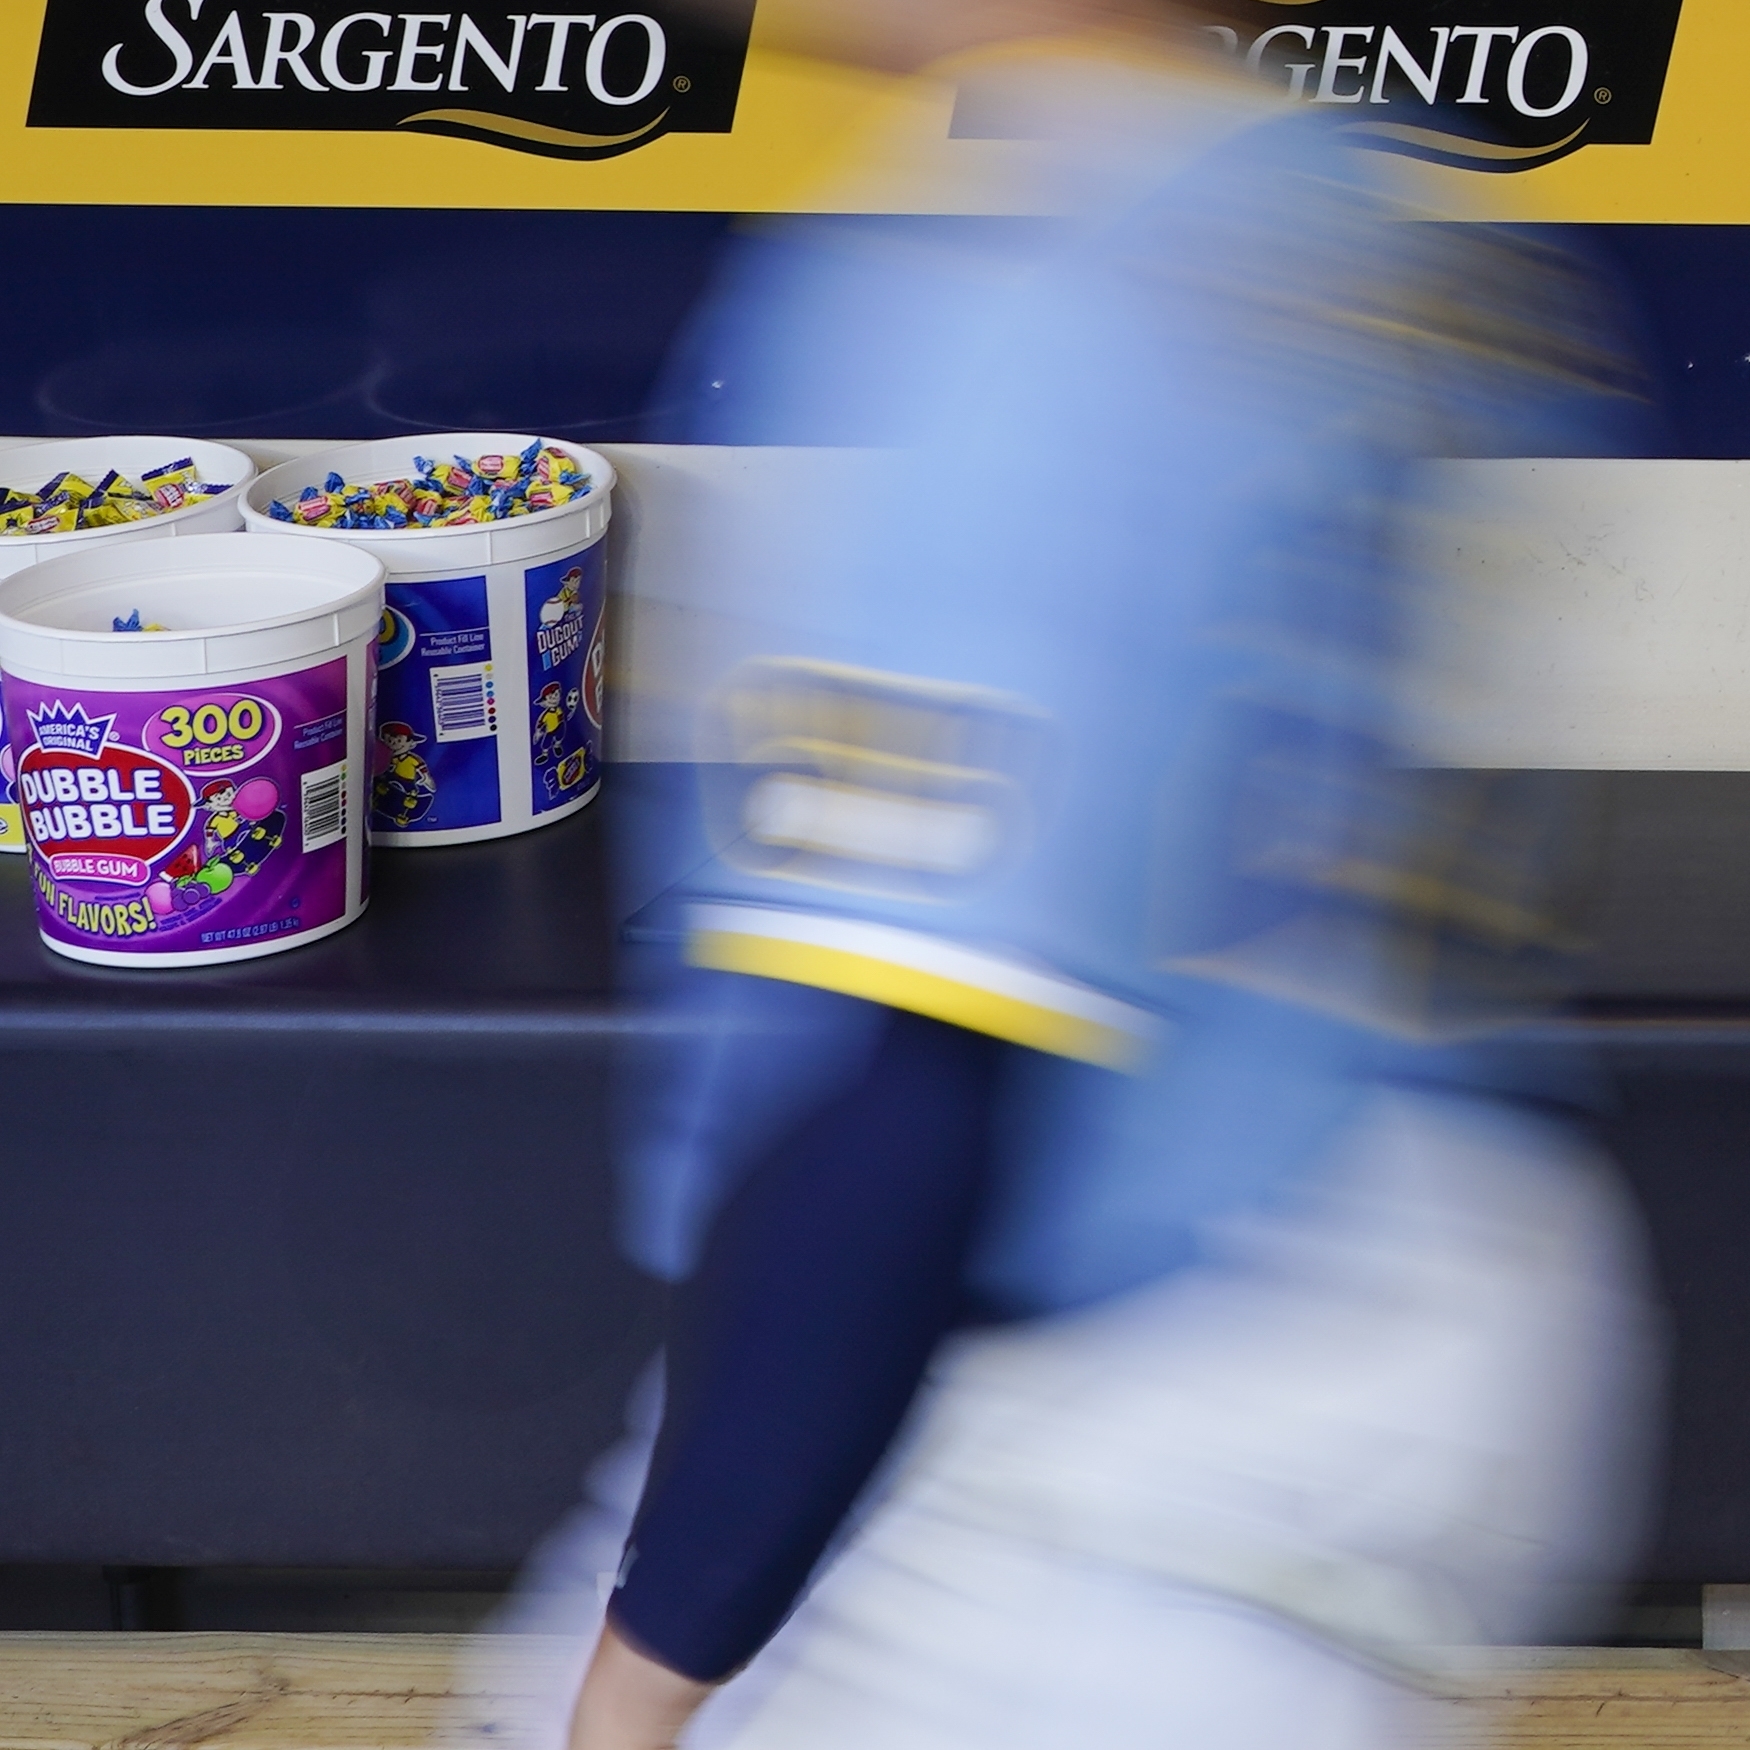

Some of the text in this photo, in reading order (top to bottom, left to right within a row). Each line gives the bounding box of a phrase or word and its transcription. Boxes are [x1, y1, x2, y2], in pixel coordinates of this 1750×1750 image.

[39, 723, 101, 741] AMERICA'S
[160, 697, 264, 749] 300
[20, 767, 164, 806] DUBBLE
[29, 803, 177, 844] BUBBLE
[96, 859, 139, 878] GUM
[58, 895, 158, 937] FLAVORS!
